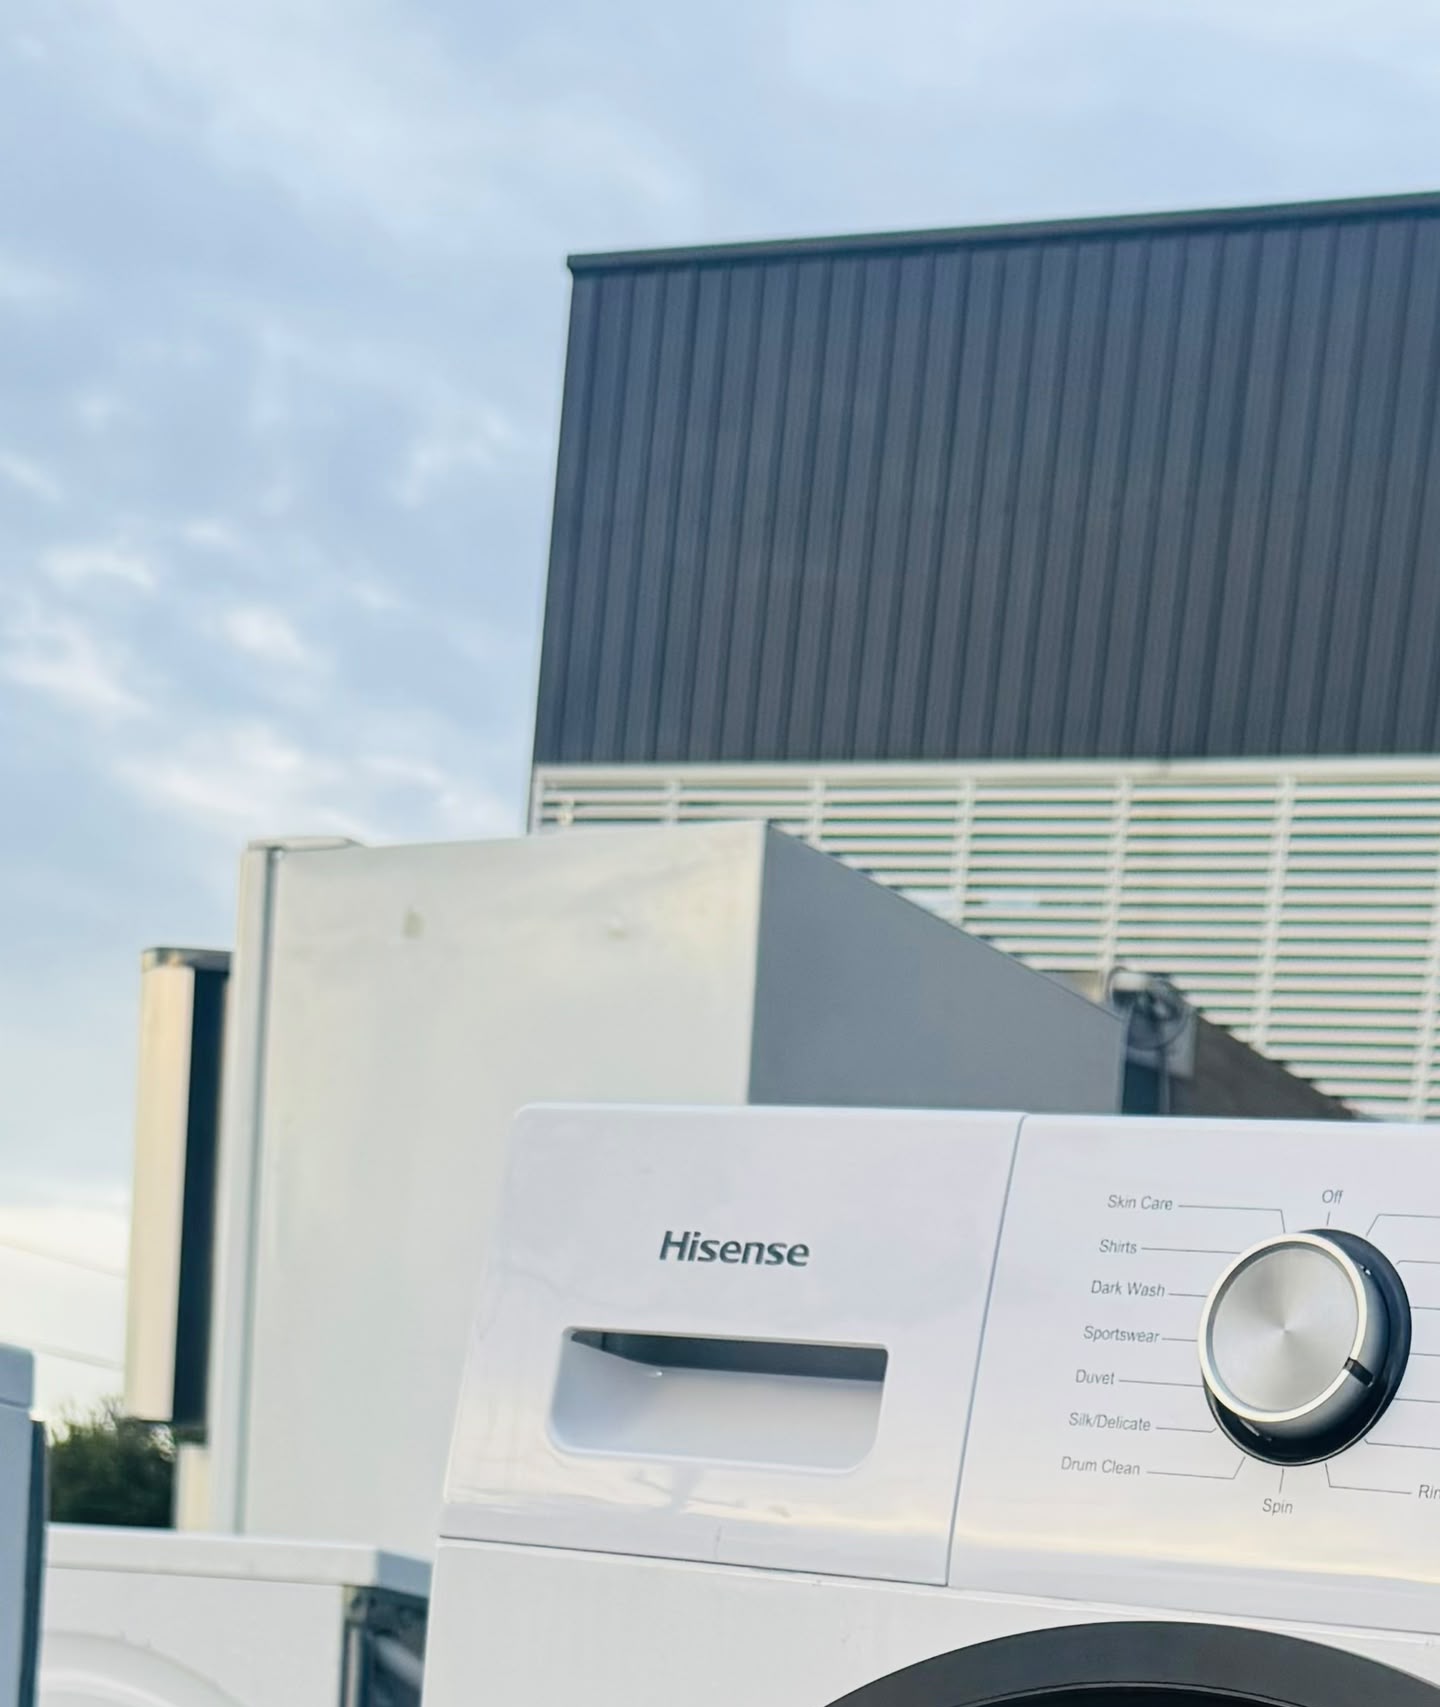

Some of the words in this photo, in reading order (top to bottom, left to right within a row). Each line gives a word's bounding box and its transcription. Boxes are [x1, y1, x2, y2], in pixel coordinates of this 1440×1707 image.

[1107, 1194, 1137, 1209] Skin
[1140, 1195, 1173, 1211] Care
[1322, 1189, 1344, 1204] Off
[658, 1230, 810, 1267] Hisense
[1099, 1239, 1137, 1254] Shirts
[1091, 1280, 1123, 1295] Dark
[1127, 1282, 1166, 1297] Wash
[1083, 1325, 1160, 1343] Sportswear
[1075, 1369, 1115, 1385] Duvet
[1068, 1412, 1151, 1431] Silk/Delicate
[1061, 1455, 1097, 1472] Drum
[1101, 1458, 1141, 1475] Clean
[1262, 1498, 1293, 1516] Spin
